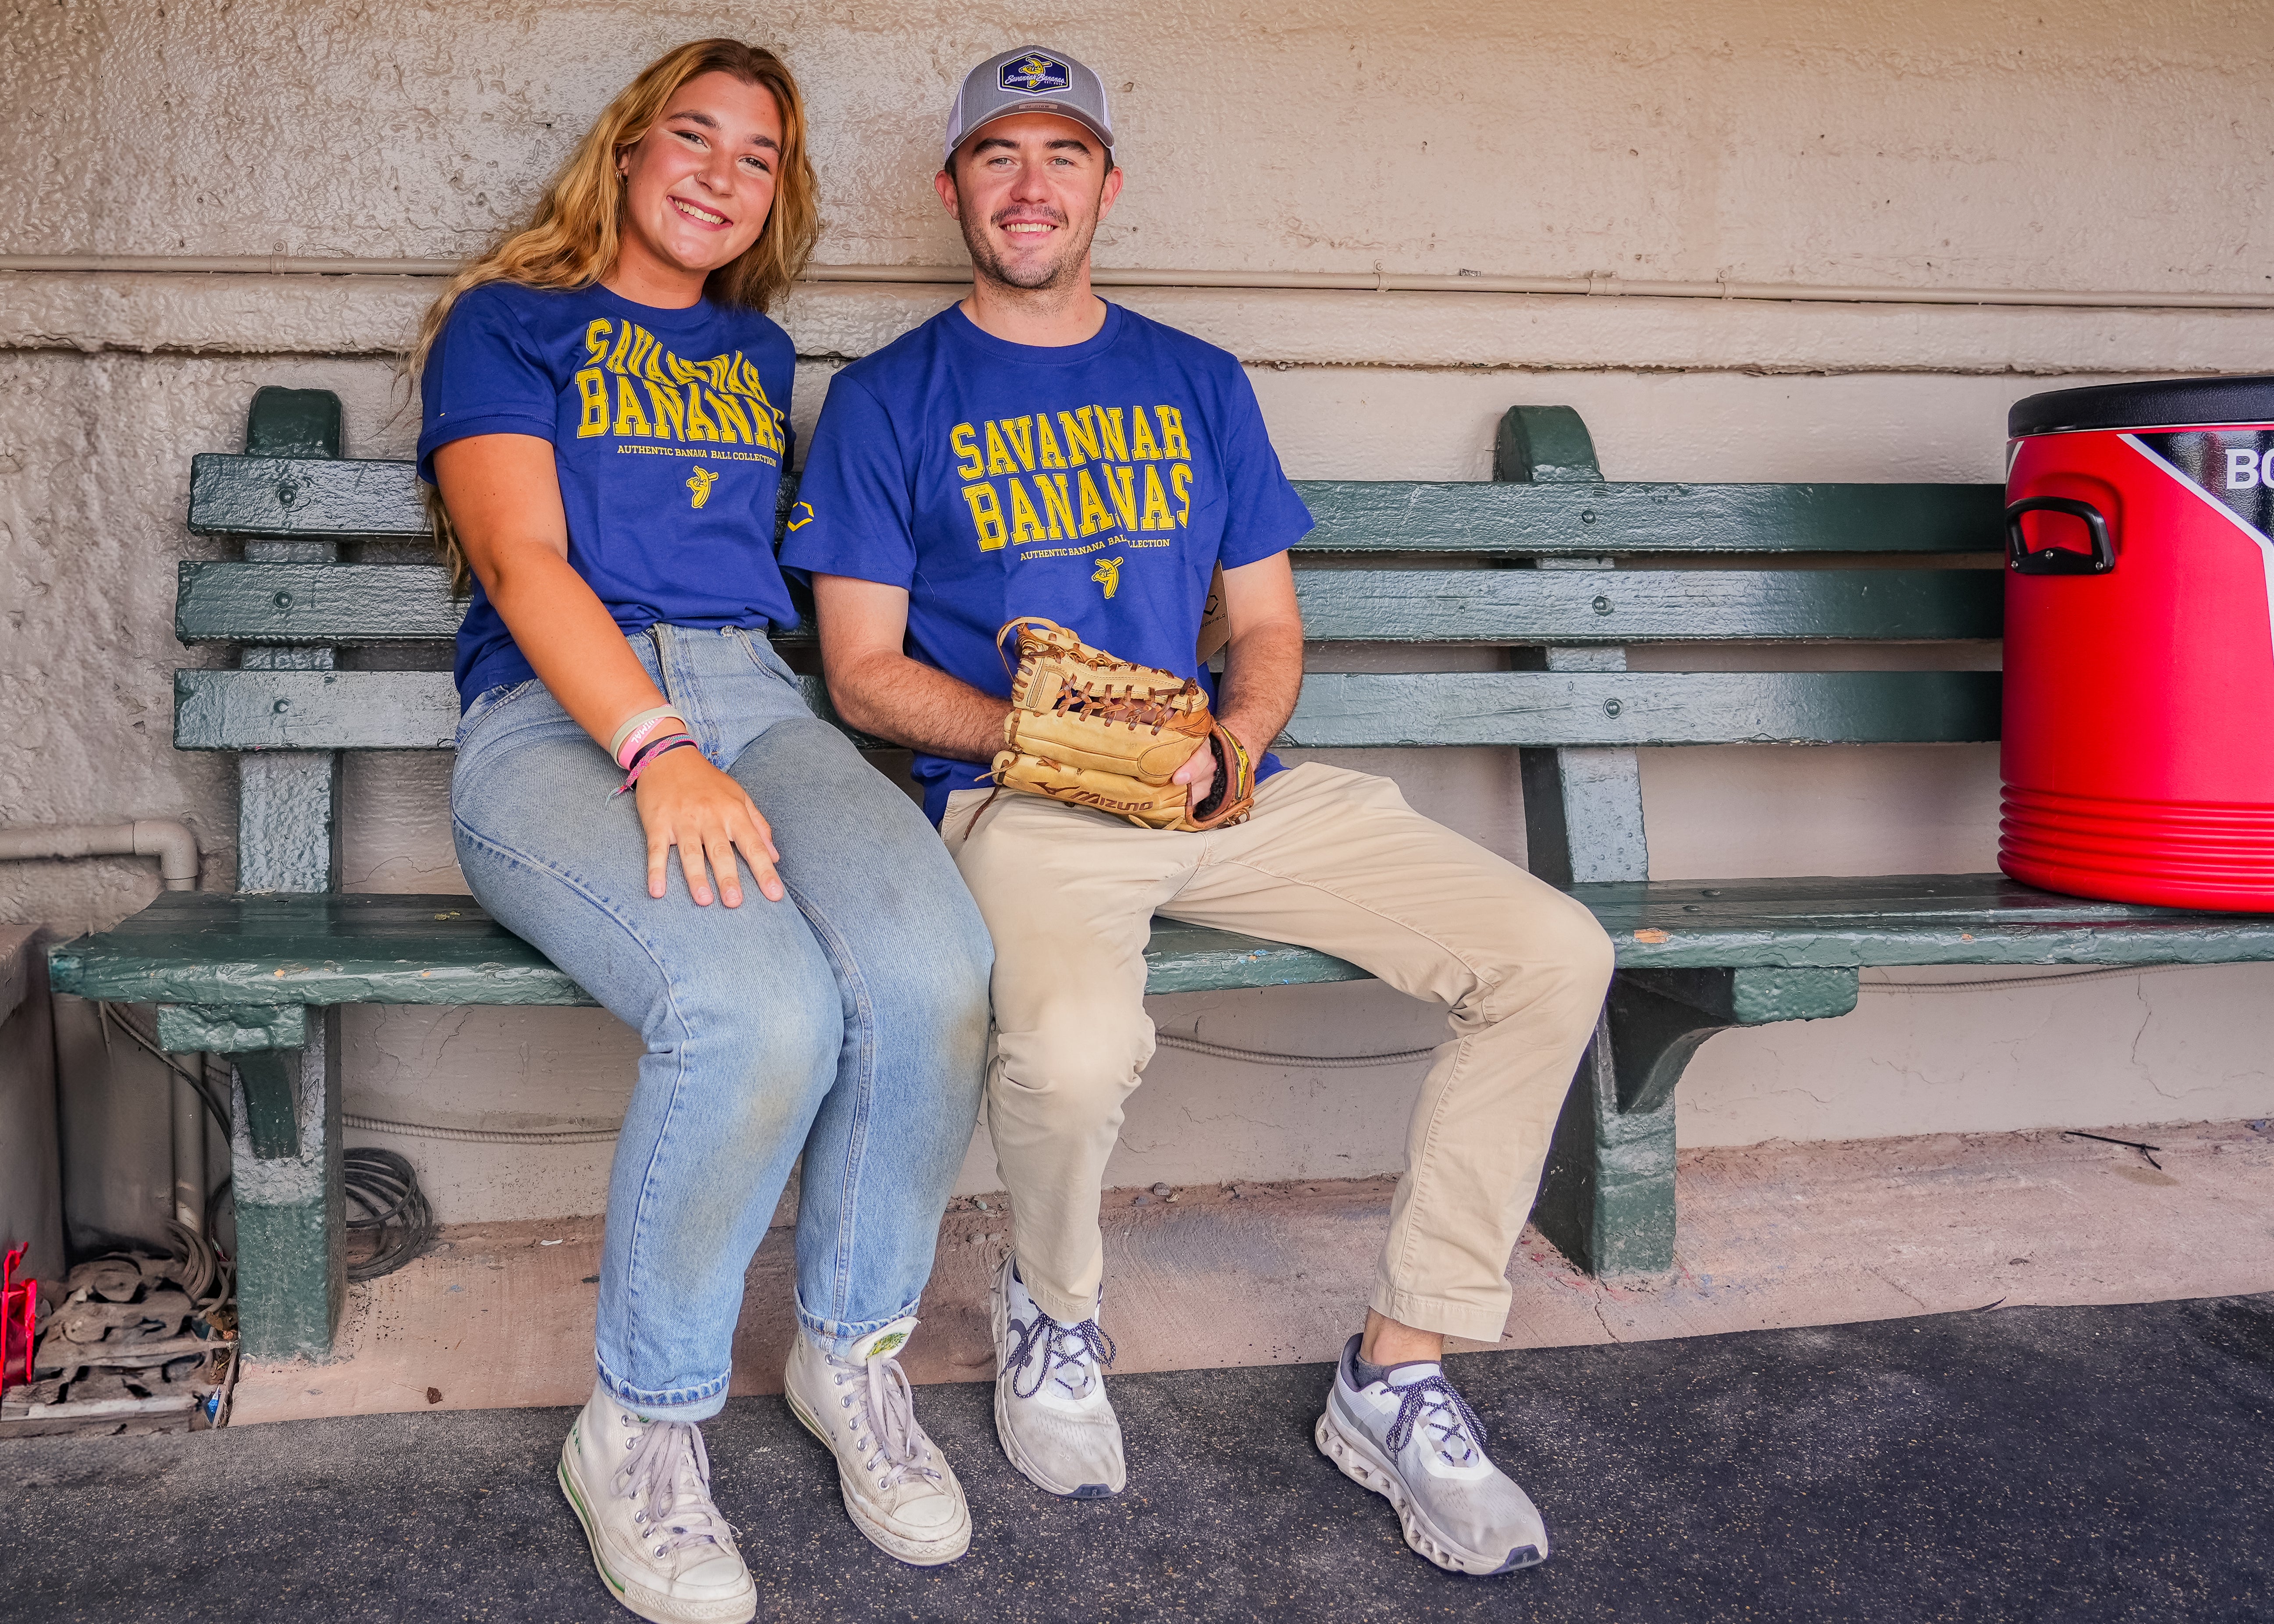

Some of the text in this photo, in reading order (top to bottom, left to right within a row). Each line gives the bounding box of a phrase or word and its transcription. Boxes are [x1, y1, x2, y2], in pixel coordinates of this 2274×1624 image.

[1004, 73, 1064, 85] Savannah Bananas
[584, 317, 772, 407] SAVANNAH
[617, 445, 777, 468] AUTHENTIC BANANA BALL COLLECTION
[949, 404, 1192, 481] SAVANNAH
[961, 462, 1193, 552] BANANAS
[1020, 548, 1068, 561] AUTHENTIC
[1069, 540, 1106, 556] BANANA
[1107, 534, 1128, 546] BAL
